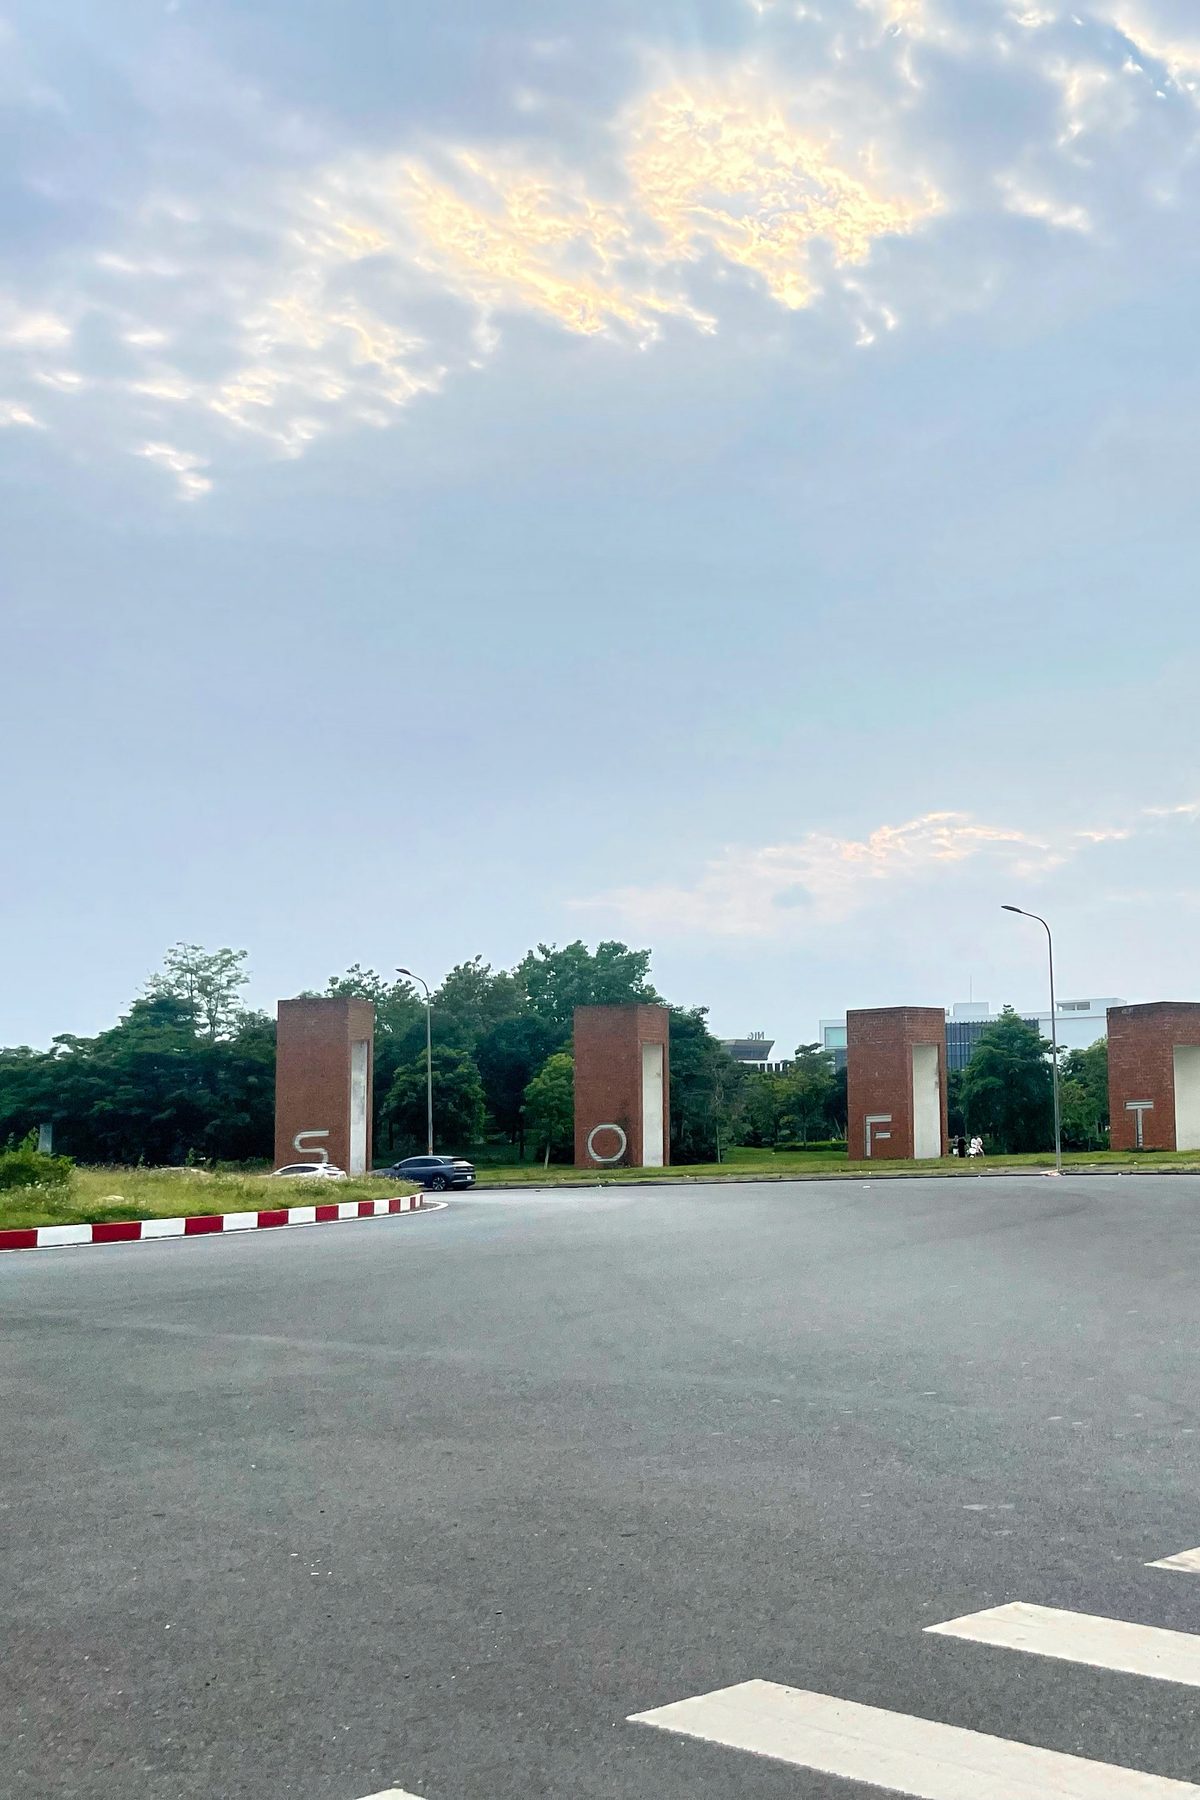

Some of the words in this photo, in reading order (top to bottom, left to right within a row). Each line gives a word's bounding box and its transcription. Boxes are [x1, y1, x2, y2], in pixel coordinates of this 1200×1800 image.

[588, 1125, 627, 1162] O
[864, 1114, 892, 1158] F
[1124, 1101, 1154, 1147] T
[294, 1130, 329, 1164] S
